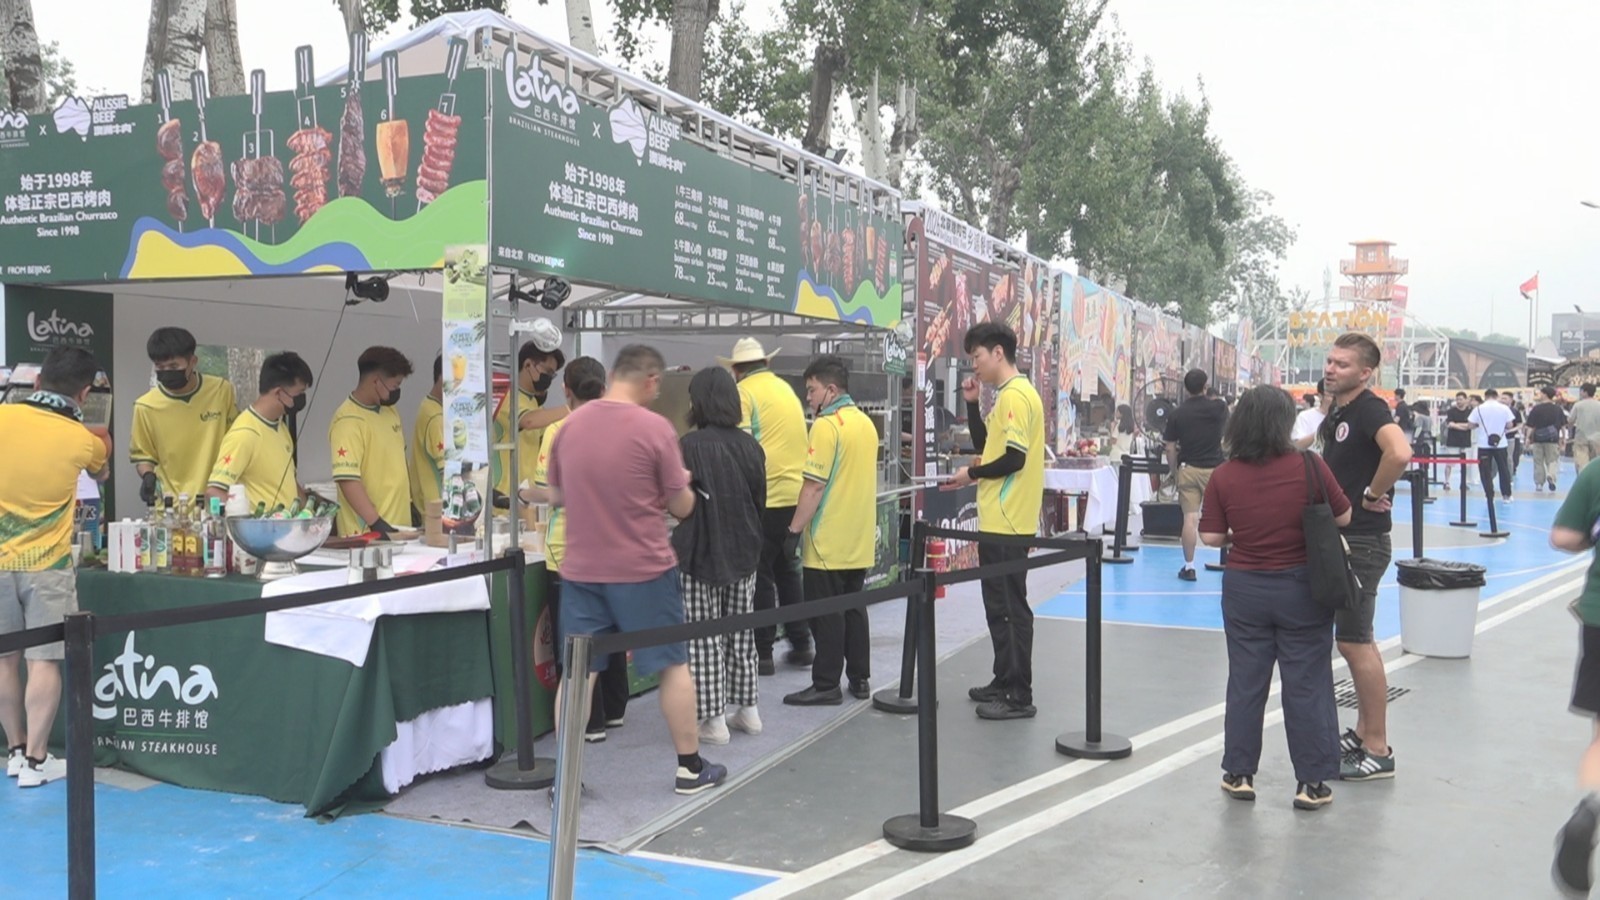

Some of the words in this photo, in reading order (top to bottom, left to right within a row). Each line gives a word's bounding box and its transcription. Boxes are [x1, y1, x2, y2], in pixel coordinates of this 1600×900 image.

[505, 51, 580, 115] Latina
[340, 87, 347, 98] 5
[92, 96, 127, 111] AUSSIE
[441, 102, 448, 113] 7
[92, 110, 116, 124] BEEF
[157, 114, 163, 124] 1
[304, 116, 311, 126] 4
[380, 109, 387, 120] 6
[534, 104, 576, 131] 巴西牛排馆
[508, 116, 541, 133] BRAZILIAN
[544, 128, 580, 147] STEAKHOUSE
[649, 115, 681, 141] AUSSIE
[192, 131, 199, 142] 2
[649, 131, 670, 153] BEEF
[248, 143, 255, 153] 3
[20, 170, 93, 191] 始于1998年
[564, 161, 626, 196] 始于1998年
[4, 189, 111, 212] 体验正宗巴西烤肉
[549, 181, 639, 222] 体验正宗巴西烤肉
[0, 214, 38, 225] Authentic
[39, 212, 74, 223] Brazilian
[75, 211, 118, 221] Churrasco
[543, 203, 580, 222] Authentic
[580, 212, 609, 229] Brazilian
[610, 220, 643, 237] Churrasco
[674, 210, 684, 225] 68
[36, 227, 58, 237] Since
[60, 225, 79, 236] 1998
[708, 220, 717, 234] 65
[577, 227, 597, 242] Since
[598, 232, 614, 245] 1998
[498, 246, 523, 261] 来自北京
[527, 253, 544, 264] FROM
[544, 255, 565, 268] BEIJING
[7, 266, 26, 275] FROM
[27, 265, 51, 276] BEIJING
[674, 264, 684, 280] 78
[707, 271, 716, 285] 25
[28, 309, 94, 342] Latina
[1289, 307, 1389, 329] STATION
[885, 337, 907, 362] Latina
[93, 630, 219, 720] atina
[124, 707, 209, 729] 巴西牛排馆
[141, 741, 218, 755] STEAKHOUSE
